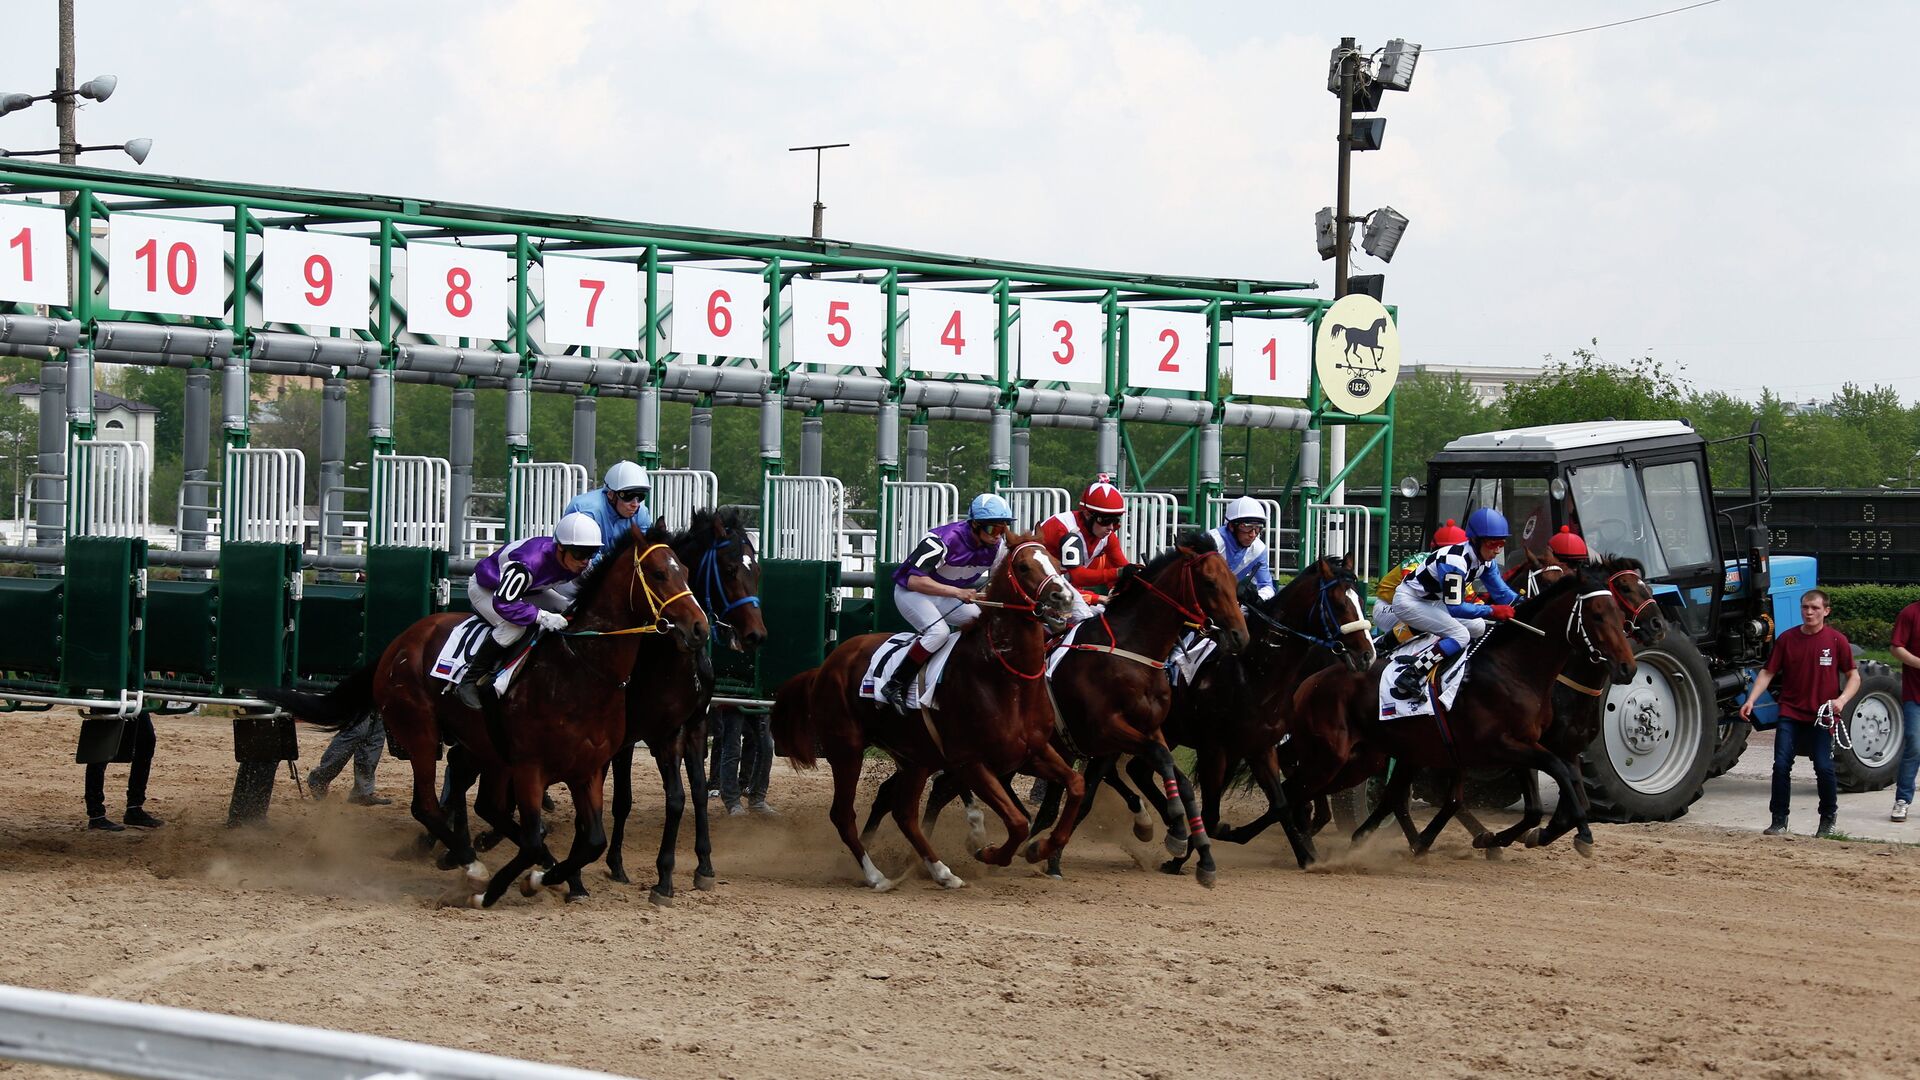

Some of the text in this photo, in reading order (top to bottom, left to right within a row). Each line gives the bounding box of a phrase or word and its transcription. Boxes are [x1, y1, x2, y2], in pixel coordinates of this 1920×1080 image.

[10, 227, 33, 282] 1
[135, 239, 198, 296] 10
[303, 254, 333, 307] 9
[445, 267, 473, 319] 8
[579, 279, 606, 328] 7
[707, 289, 733, 337] 6
[827, 301, 852, 347] 5
[940, 310, 966, 356] 4
[1052, 319, 1075, 365] 3
[1158, 328, 1180, 373] 2
[1262, 337, 1277, 381] 1
[1351, 382, 1376, 392] 1834
[1400, 501, 1410, 518] 3
[1761, 503, 1773, 522] 7
[1863, 503, 1876, 523] 8
[914, 537, 944, 569] 7
[1061, 535, 1080, 566] 6
[1389, 525, 1423, 542] 999
[1849, 530, 1892, 549] 999
[497, 567, 526, 602] 10
[1444, 573, 1463, 605] 3
[873, 638, 912, 679] 7
